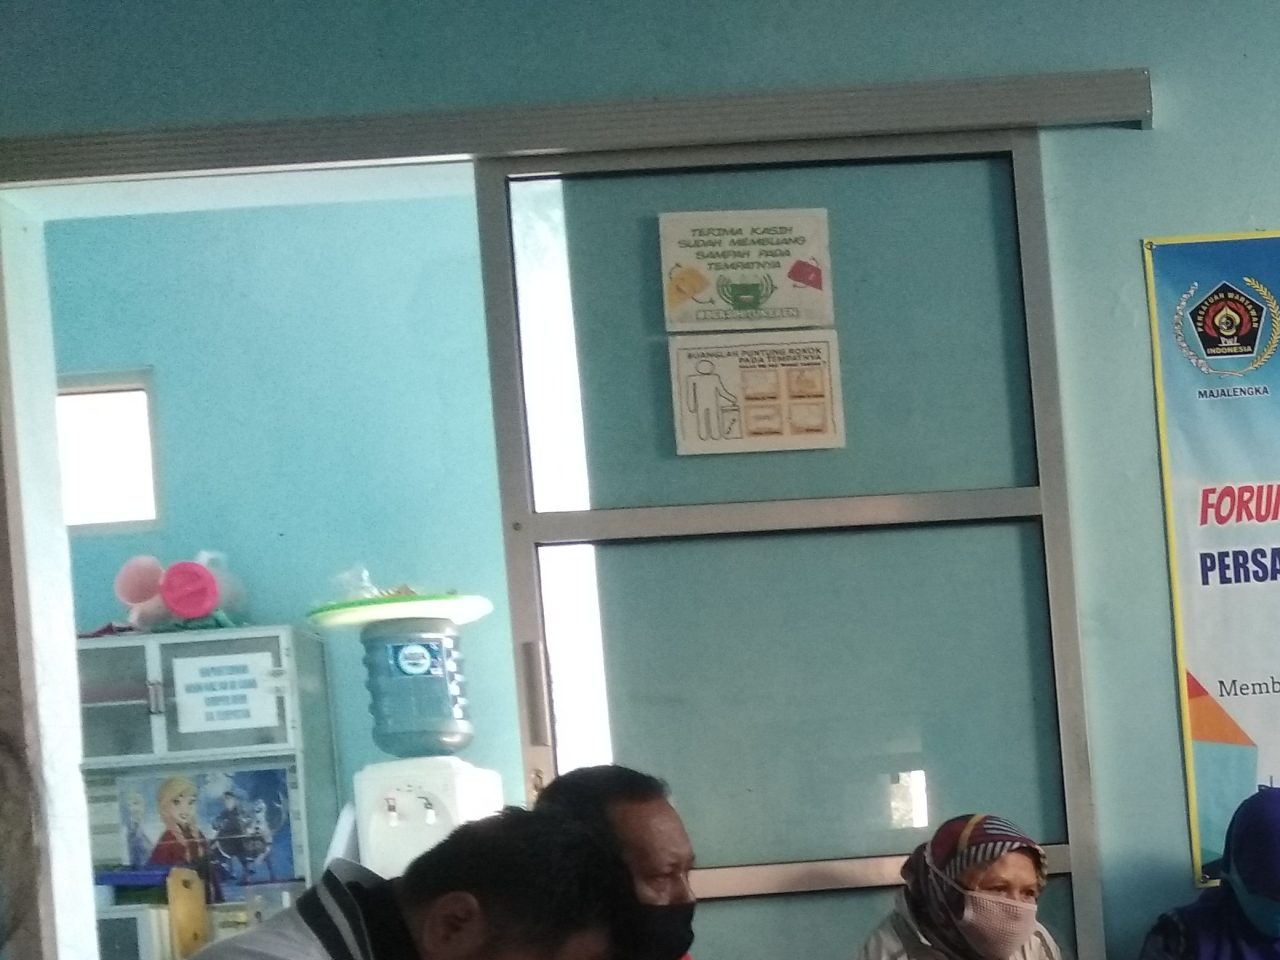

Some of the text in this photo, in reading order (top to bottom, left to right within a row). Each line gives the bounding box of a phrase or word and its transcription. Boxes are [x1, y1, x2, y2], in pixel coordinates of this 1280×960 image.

[691, 226, 793, 237] TERIMA KASIH
[678, 237, 805, 249] SUDAH MEMBUANG
[695, 249, 790, 260] SAMPAH PADA
[708, 261, 781, 270] TEMPATNYA
[1197, 292, 1259, 332] PERSATUAN WARTAWAN
[1206, 345, 1253, 355] INDONESIA
[1197, 386, 1270, 399] MAJALENGKA
